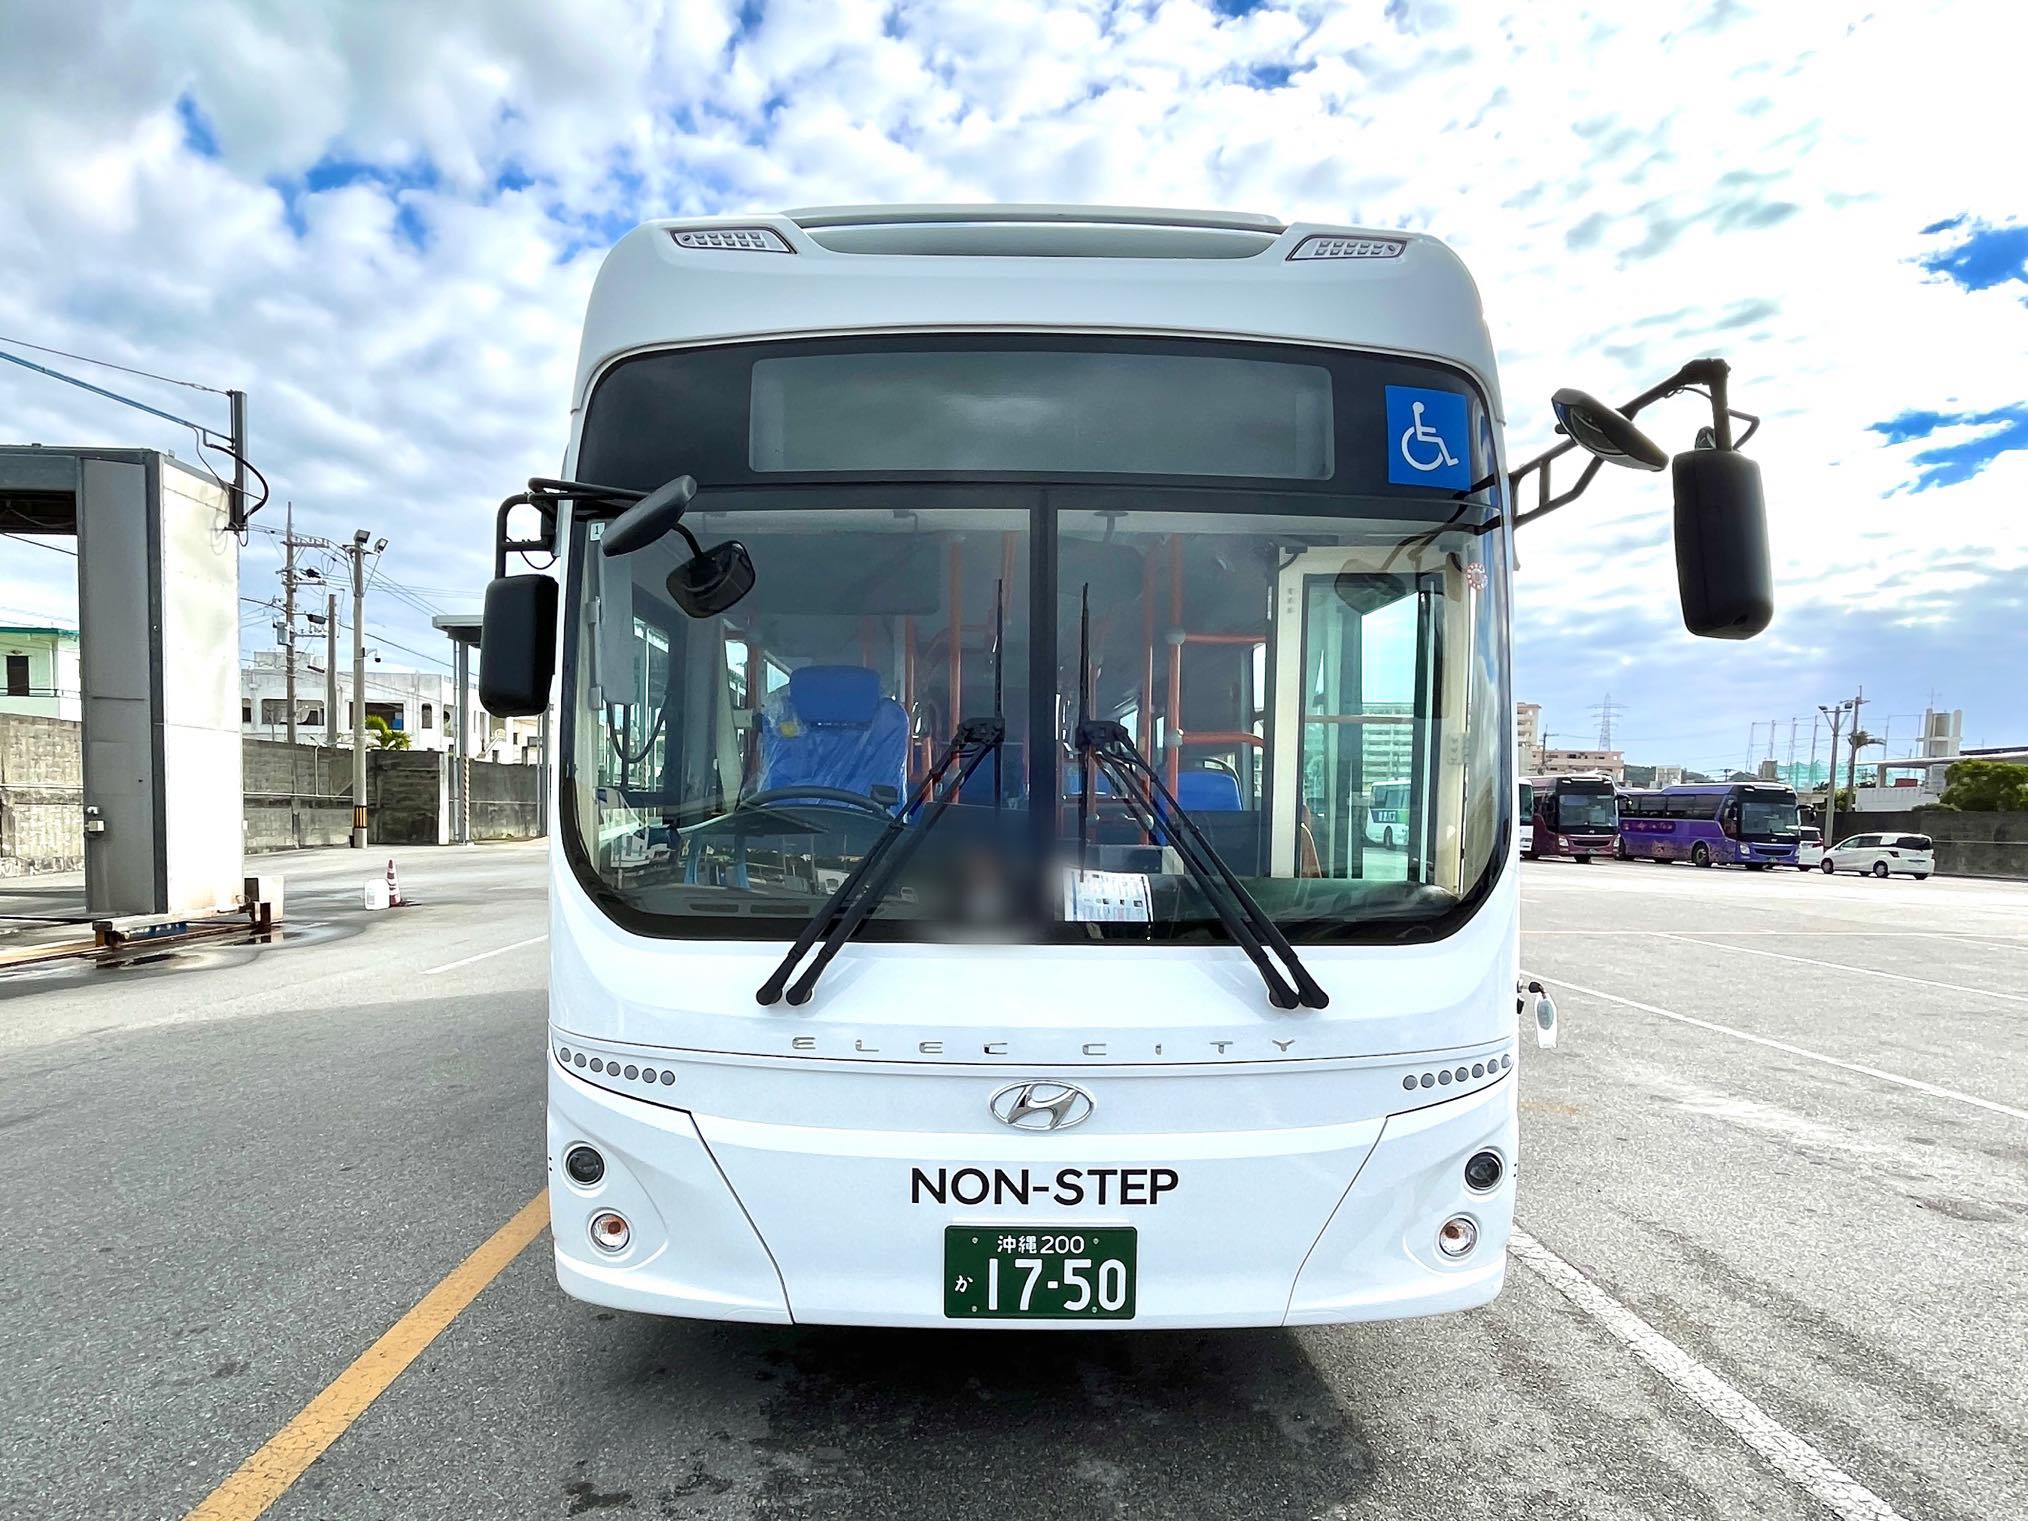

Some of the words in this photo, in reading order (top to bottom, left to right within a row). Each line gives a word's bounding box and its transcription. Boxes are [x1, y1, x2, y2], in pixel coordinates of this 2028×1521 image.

[792, 1036, 1008, 1055] ELEC
[1082, 1039, 1296, 1056] CITY
[911, 1167, 1179, 1205] NON-STEP
